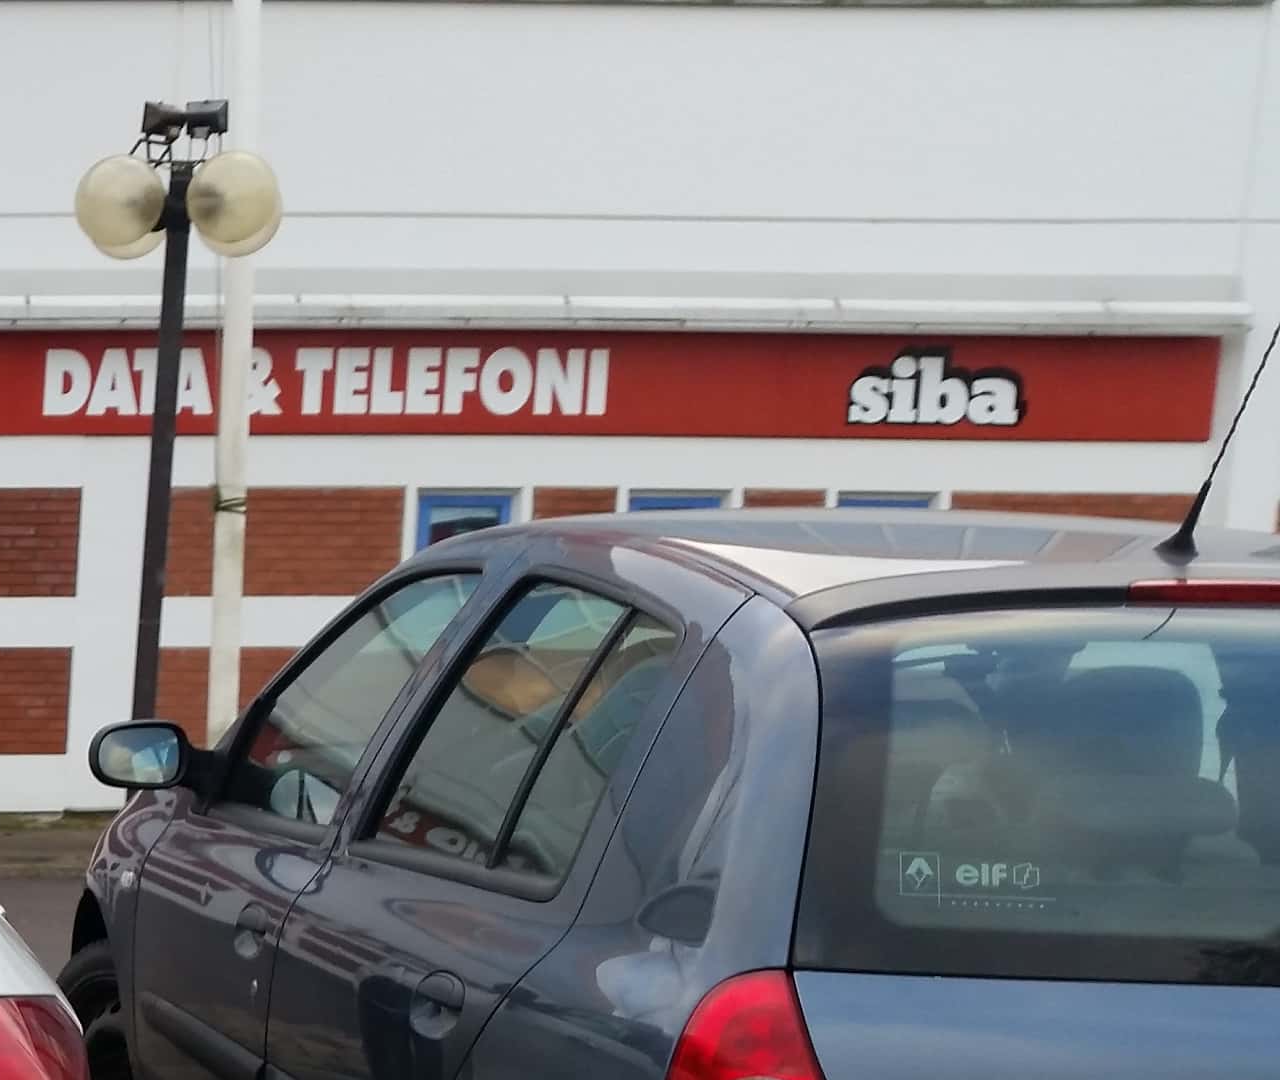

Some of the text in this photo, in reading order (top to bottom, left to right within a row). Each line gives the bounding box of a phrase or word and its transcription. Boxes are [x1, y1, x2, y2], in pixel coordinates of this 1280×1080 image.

[42, 346, 611, 416] DATA & TELEFONI
[847, 354, 1020, 425] siba
[955, 863, 1007, 887] elf
